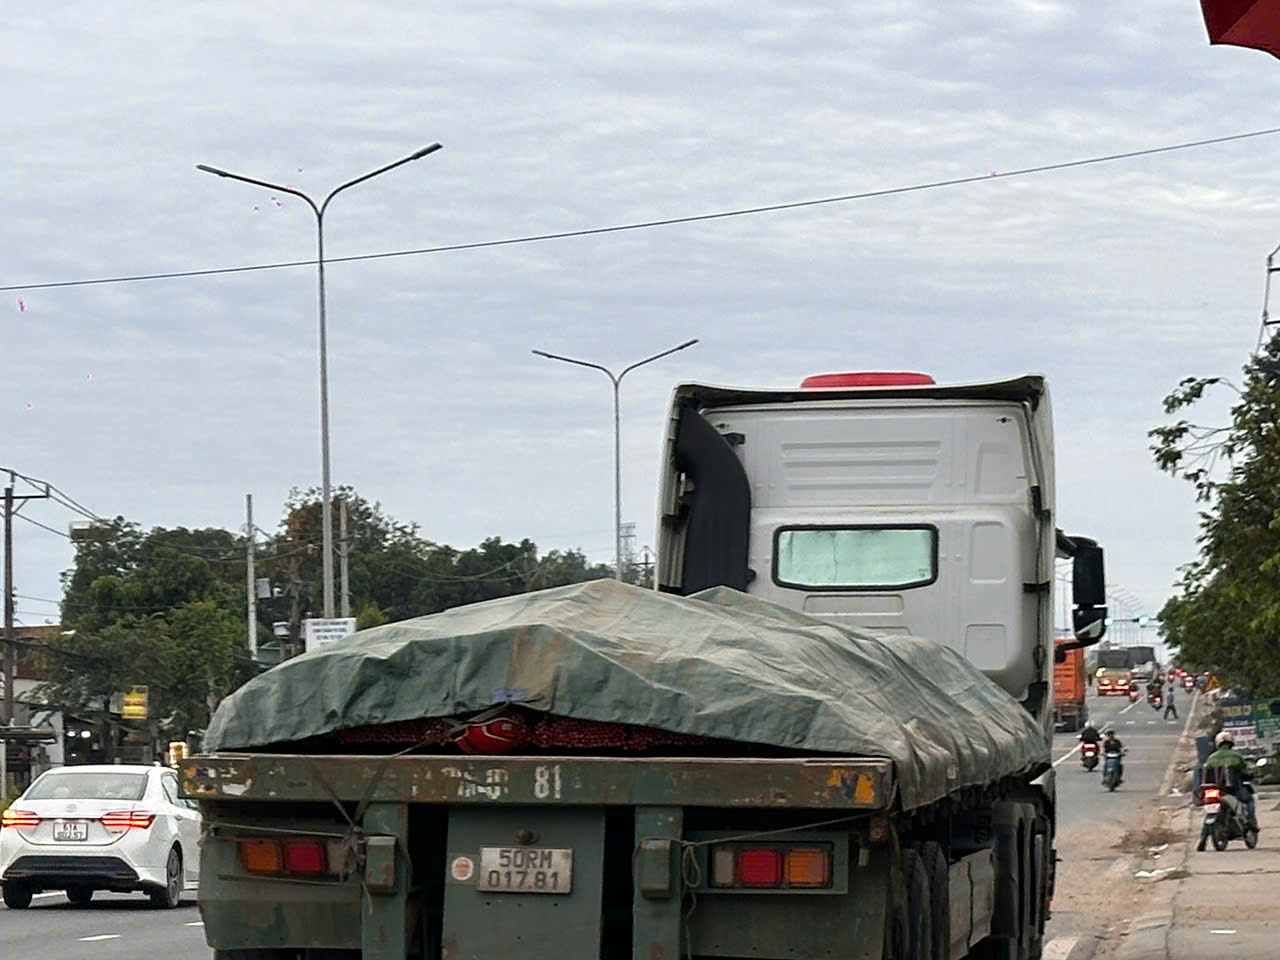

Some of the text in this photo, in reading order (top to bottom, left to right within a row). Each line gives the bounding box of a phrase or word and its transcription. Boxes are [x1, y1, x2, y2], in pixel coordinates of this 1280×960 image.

[534, 765, 562, 799] 81
[498, 849, 553, 870] 50RM
[487, 869, 560, 890] 017.81
